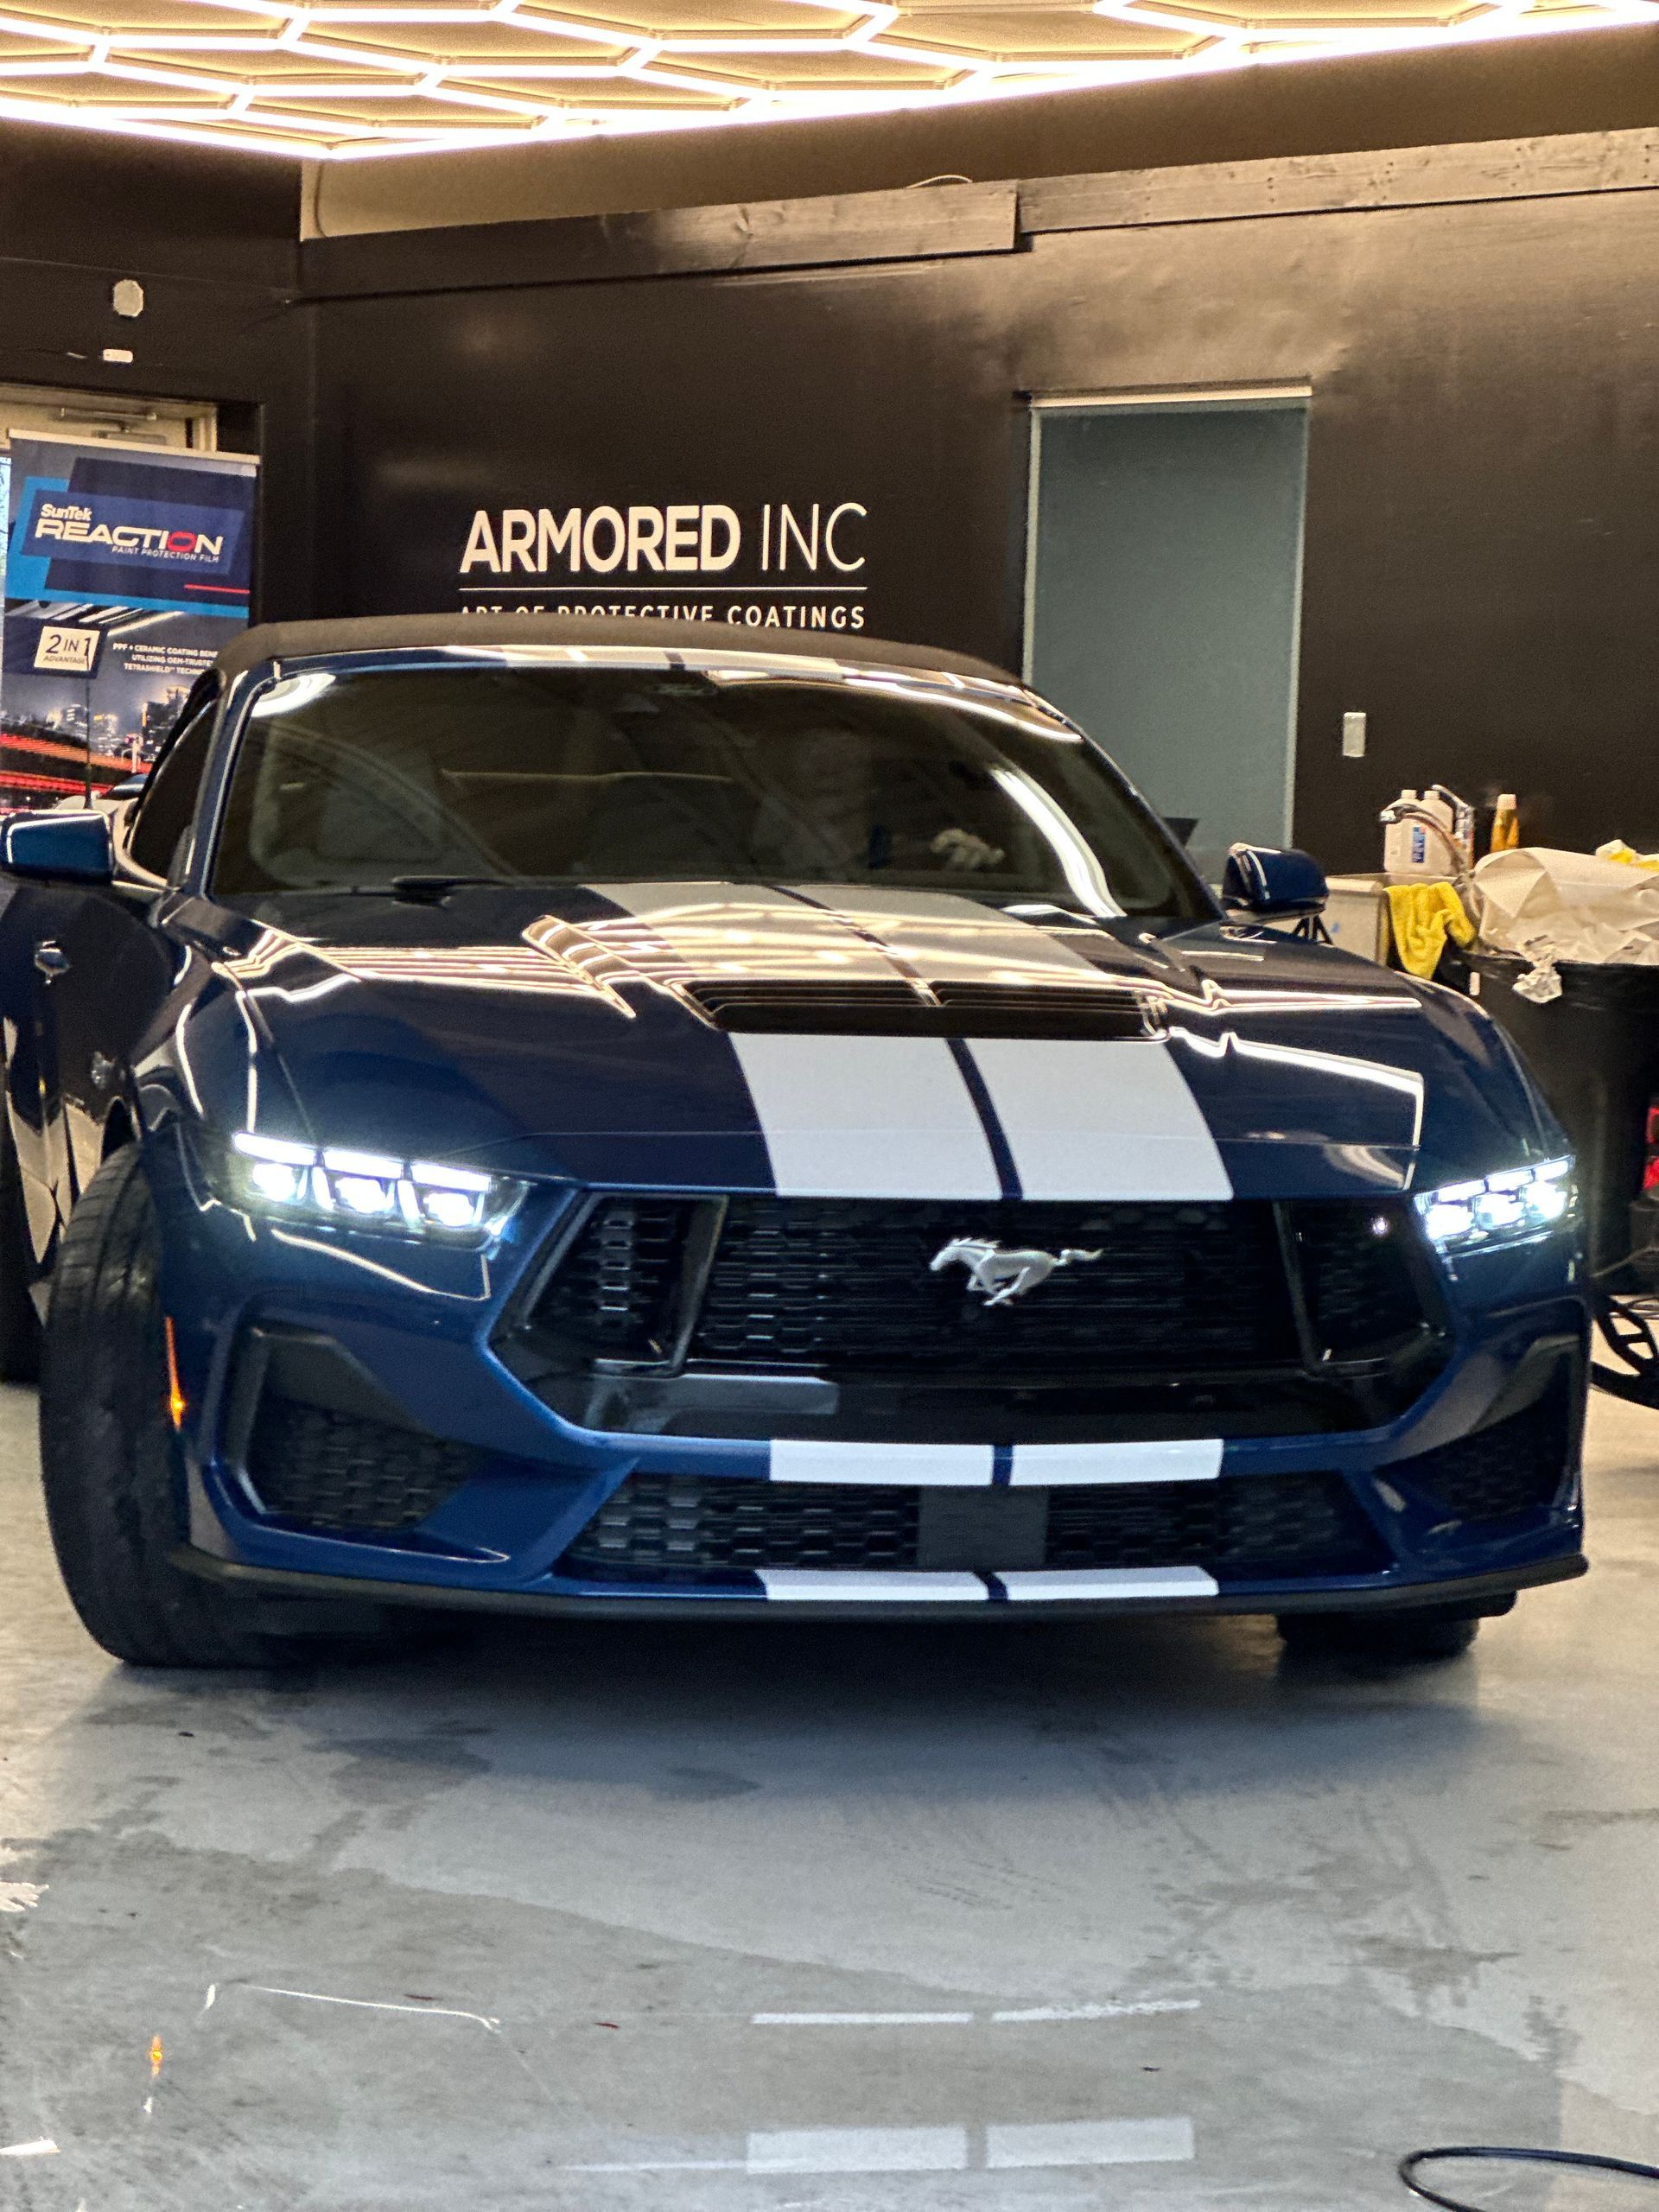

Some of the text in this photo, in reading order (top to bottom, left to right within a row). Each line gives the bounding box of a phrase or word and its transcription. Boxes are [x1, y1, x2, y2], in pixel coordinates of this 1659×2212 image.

[41, 503, 92, 521] SunTek
[35, 518, 224, 555] REACTION
[460, 502, 868, 573] ARMORED INC
[111, 545, 220, 563] PAINT PROTECTION FILM
[727, 606, 865, 629] COATINGS
[46, 633, 92, 657] 2 IN 1
[112, 642, 128, 651] PPF
[134, 645, 166, 654] CERAMIC
[167, 647, 199, 657] COATING
[43, 656, 86, 664] ADVANTAGE
[131, 654, 166, 664] UTILIZING
